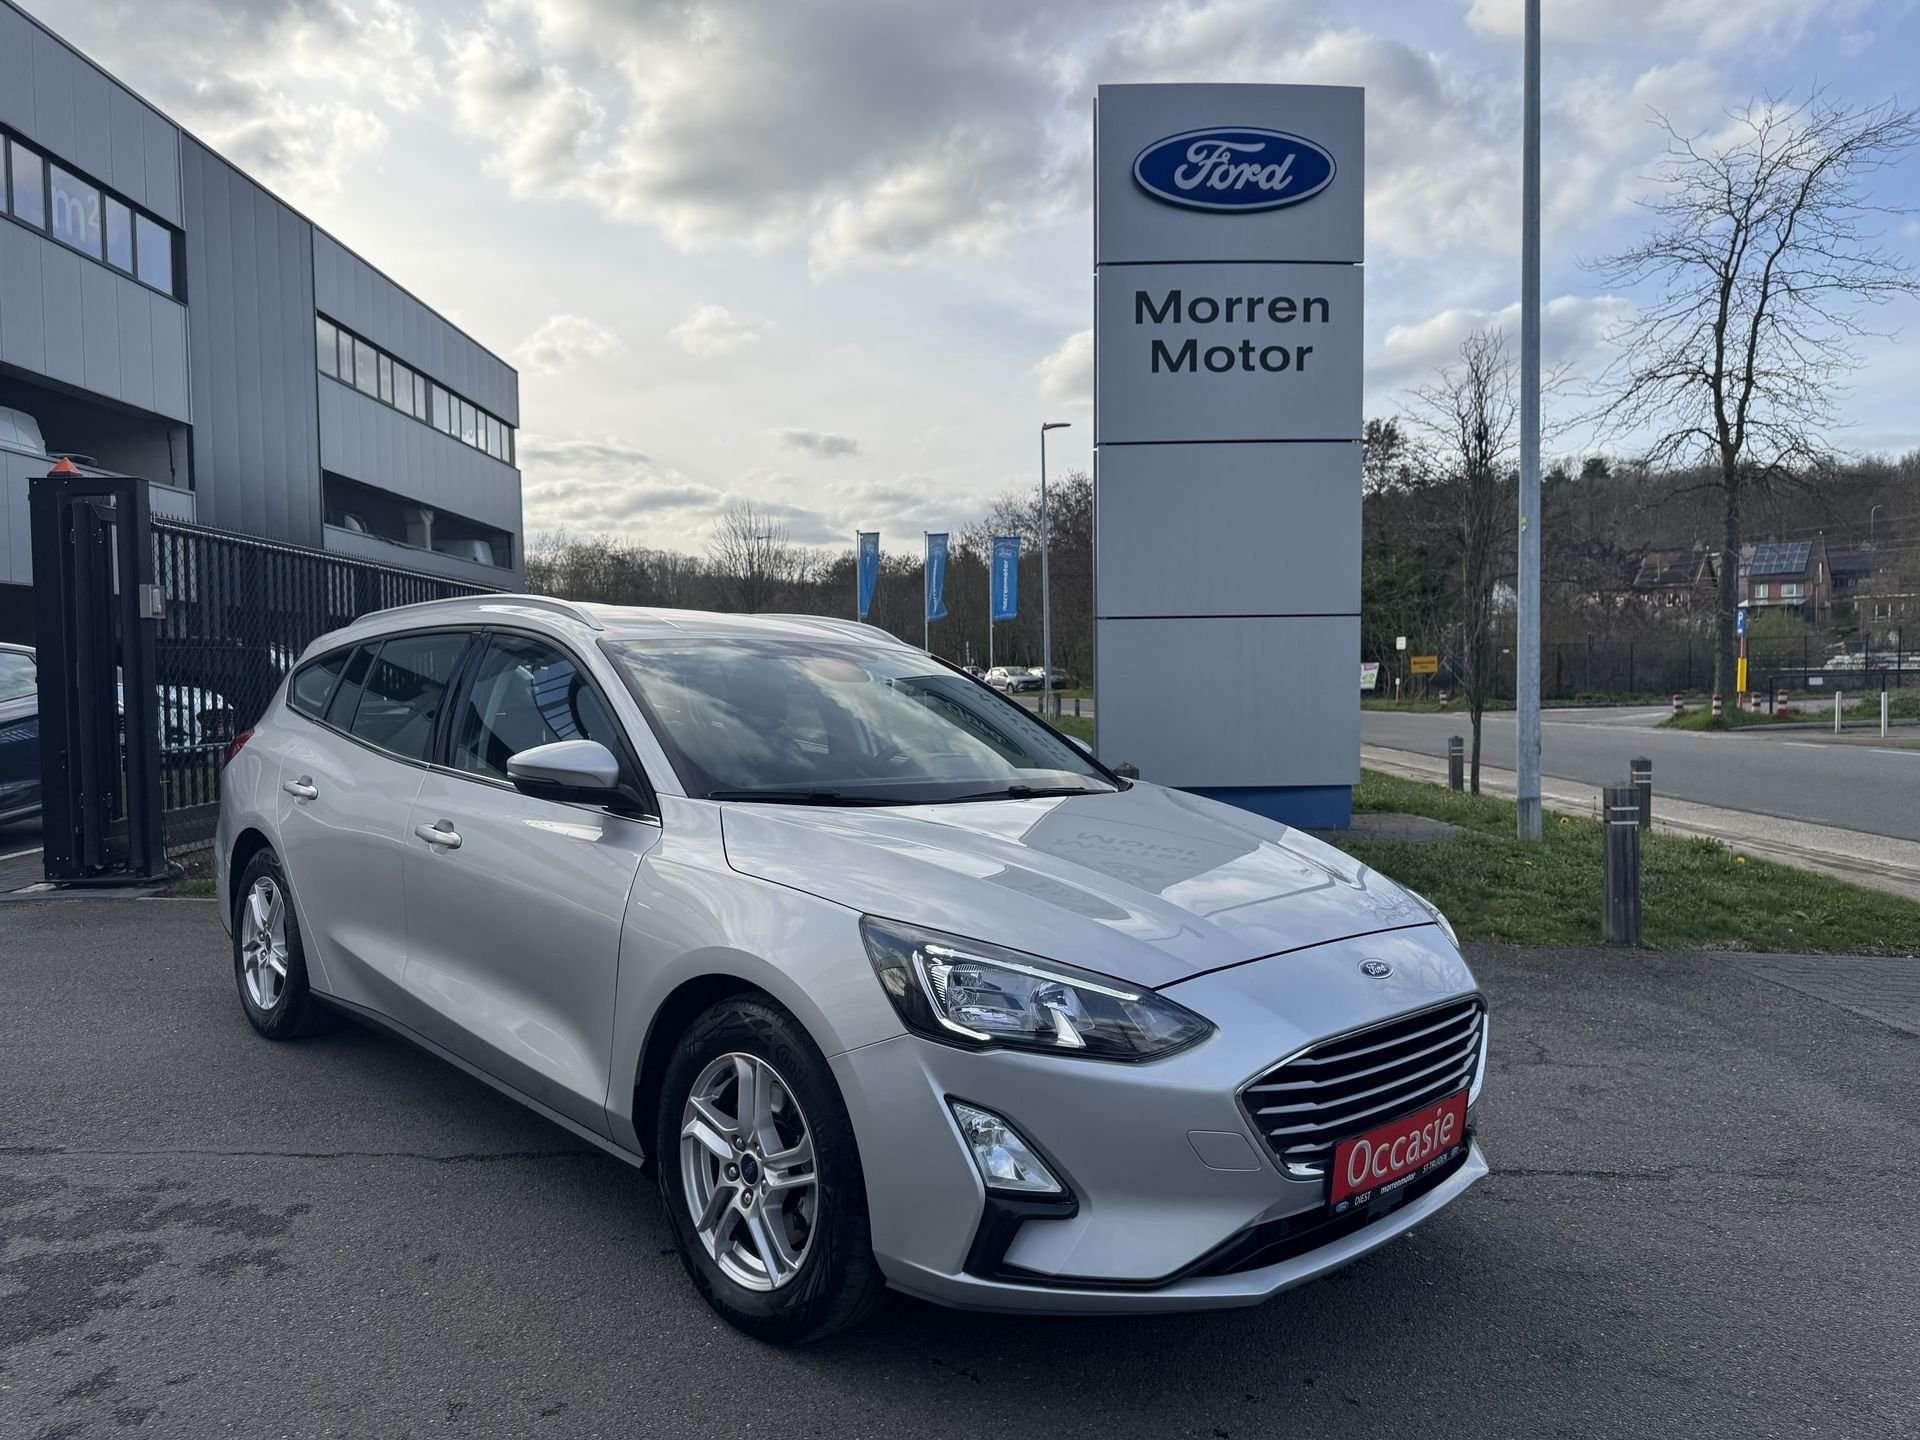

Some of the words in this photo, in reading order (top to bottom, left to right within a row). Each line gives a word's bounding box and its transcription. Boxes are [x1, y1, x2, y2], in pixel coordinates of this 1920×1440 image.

[1173, 139, 1296, 191] Ford
[1135, 289, 1330, 324] Morren
[1151, 338, 1313, 373] Motor
[1347, 1107, 1455, 1188] Occasie
